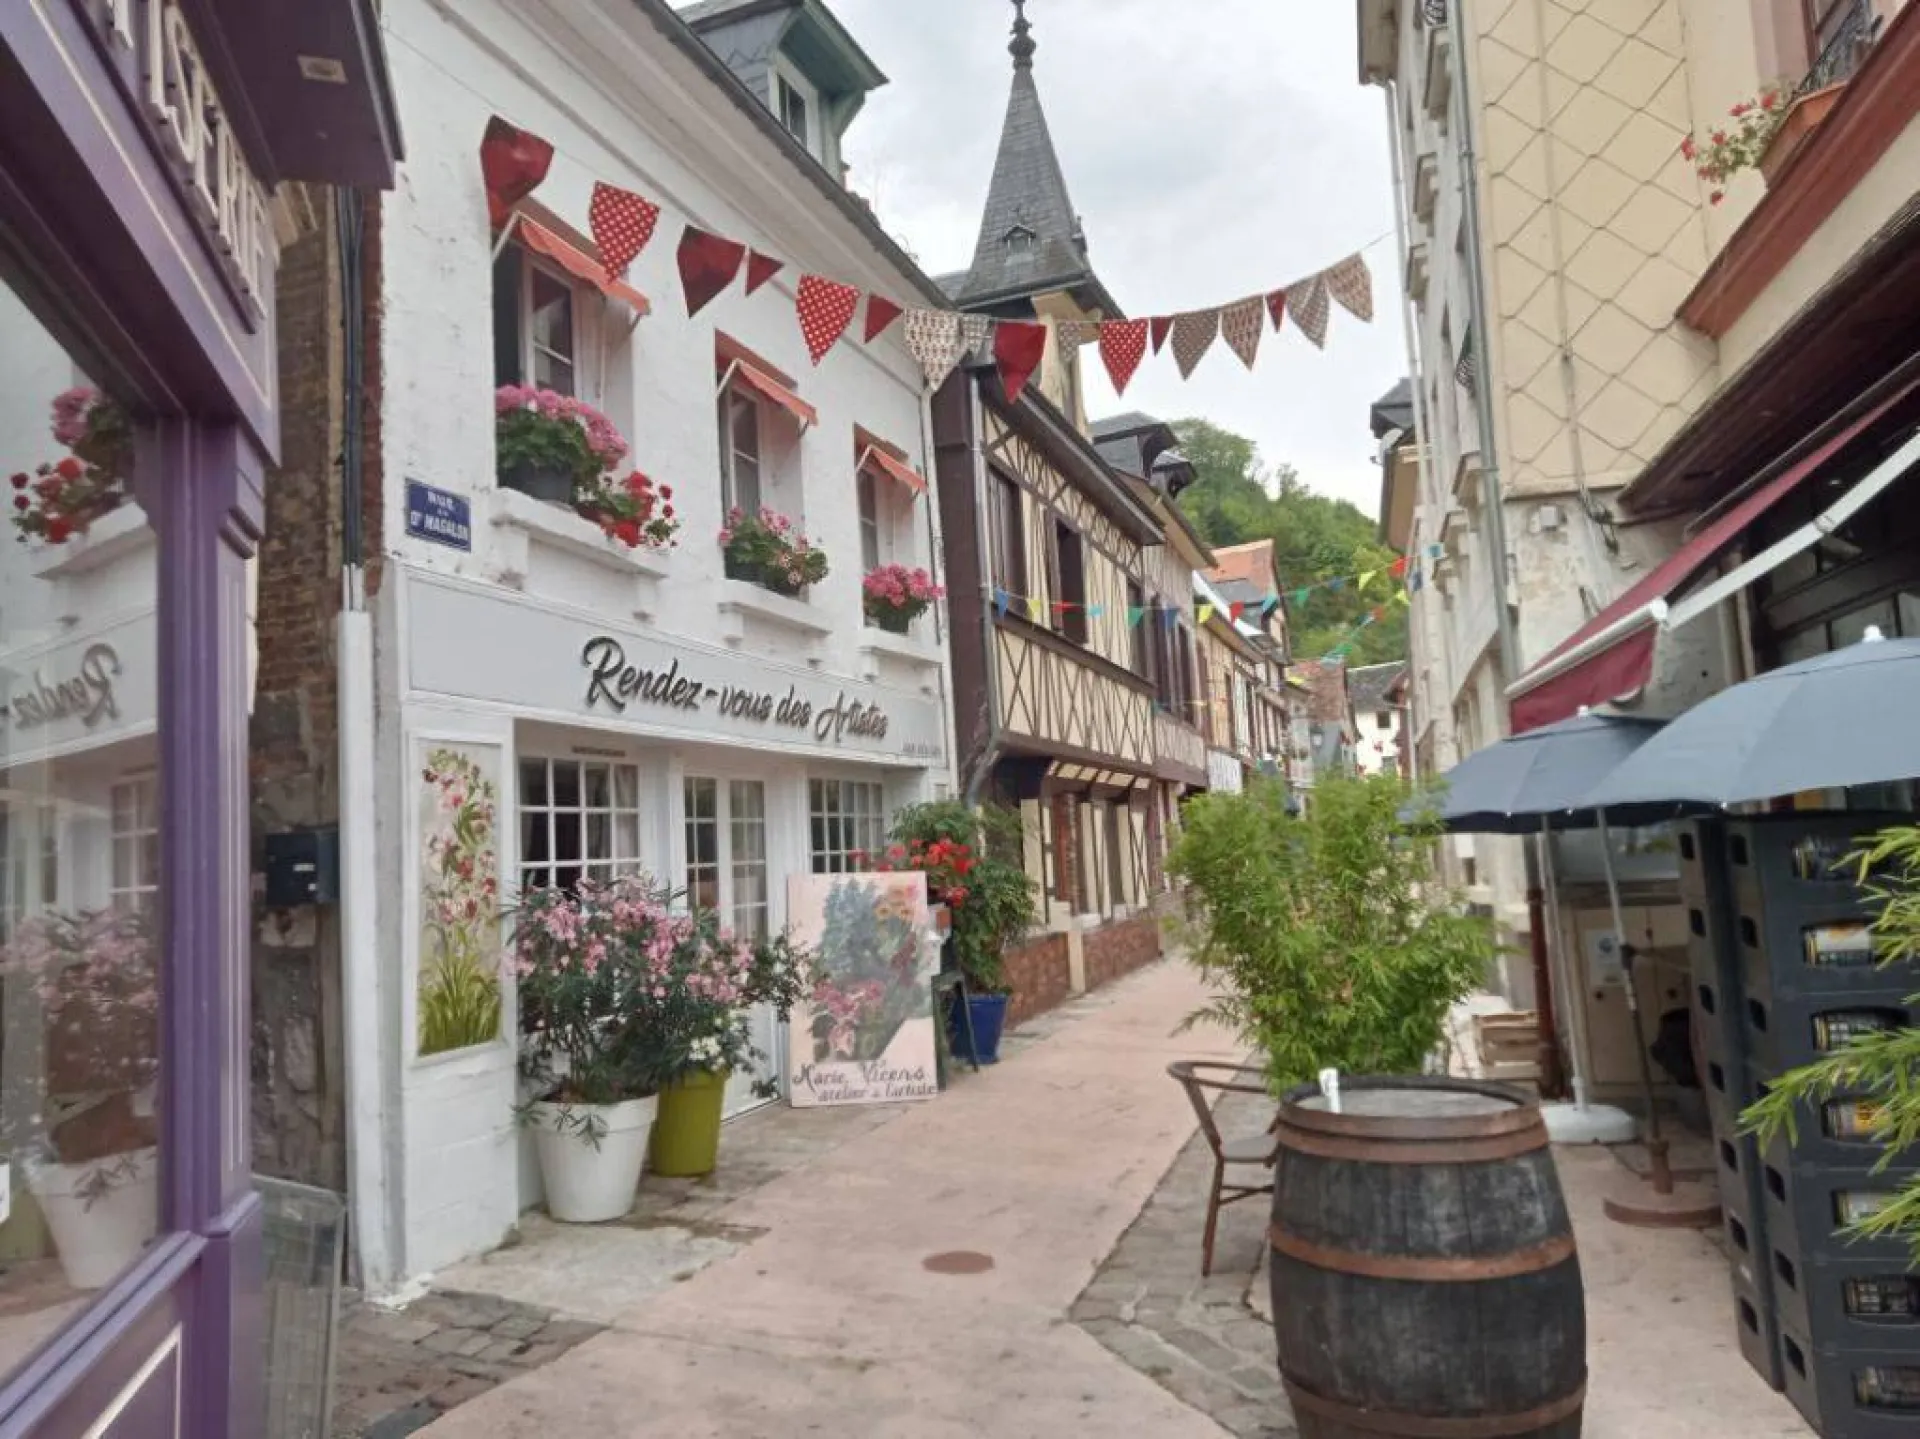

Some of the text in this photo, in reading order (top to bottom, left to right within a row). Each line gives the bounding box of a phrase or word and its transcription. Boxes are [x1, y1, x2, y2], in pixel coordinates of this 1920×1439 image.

[581, 636, 889, 744] Rendez-vous des Artistes
